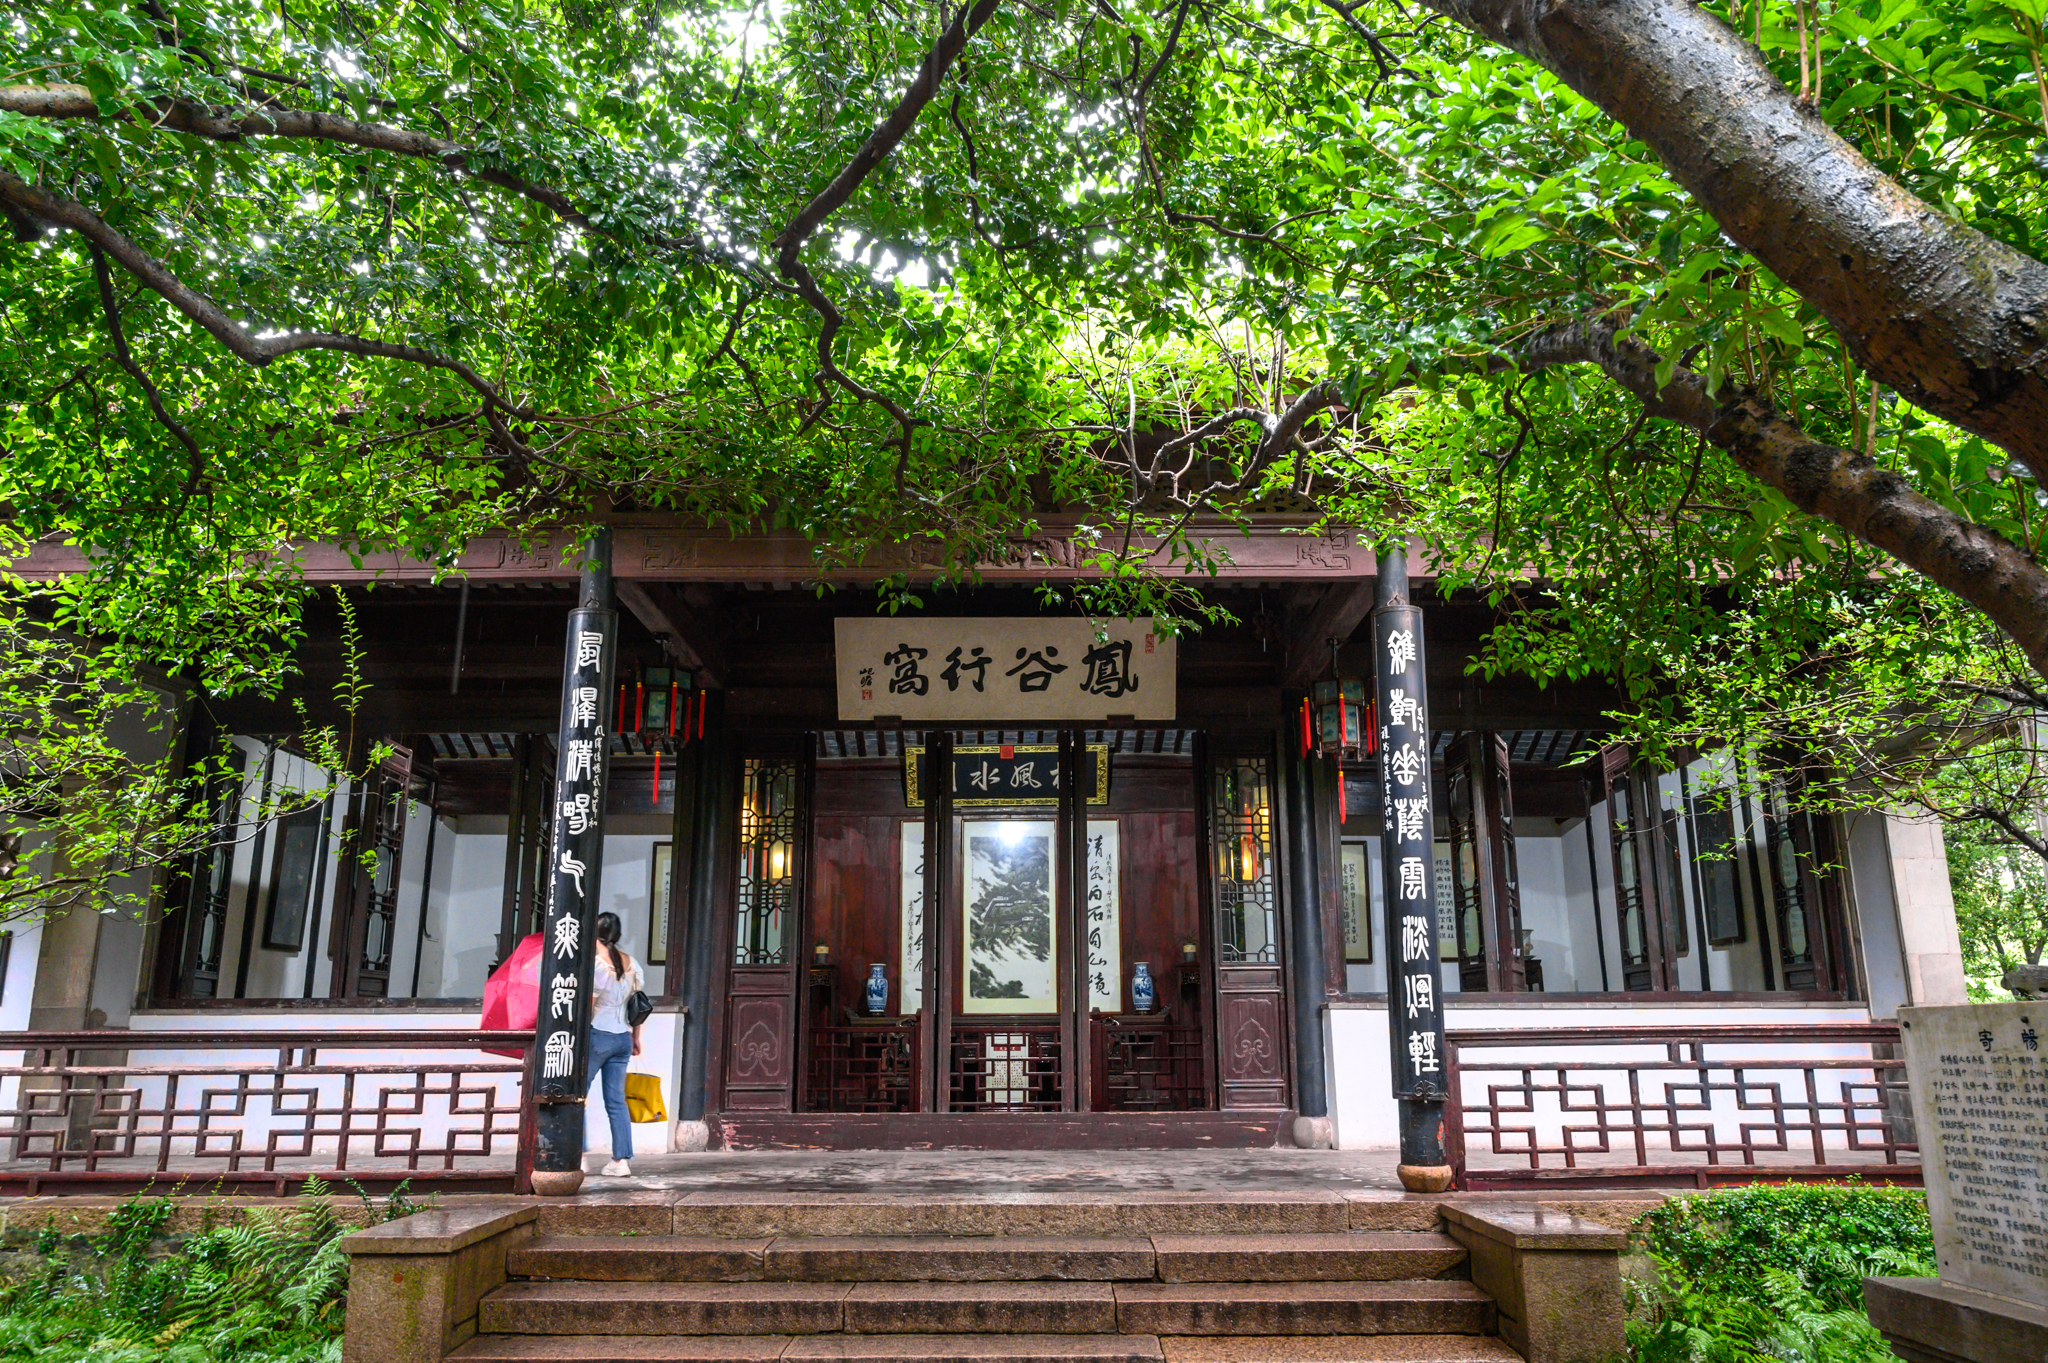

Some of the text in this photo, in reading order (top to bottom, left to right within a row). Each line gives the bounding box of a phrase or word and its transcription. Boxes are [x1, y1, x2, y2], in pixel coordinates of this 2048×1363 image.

[883, 639, 1139, 698] 鳳谷行窩
[952, 760, 1060, 793] 風水
